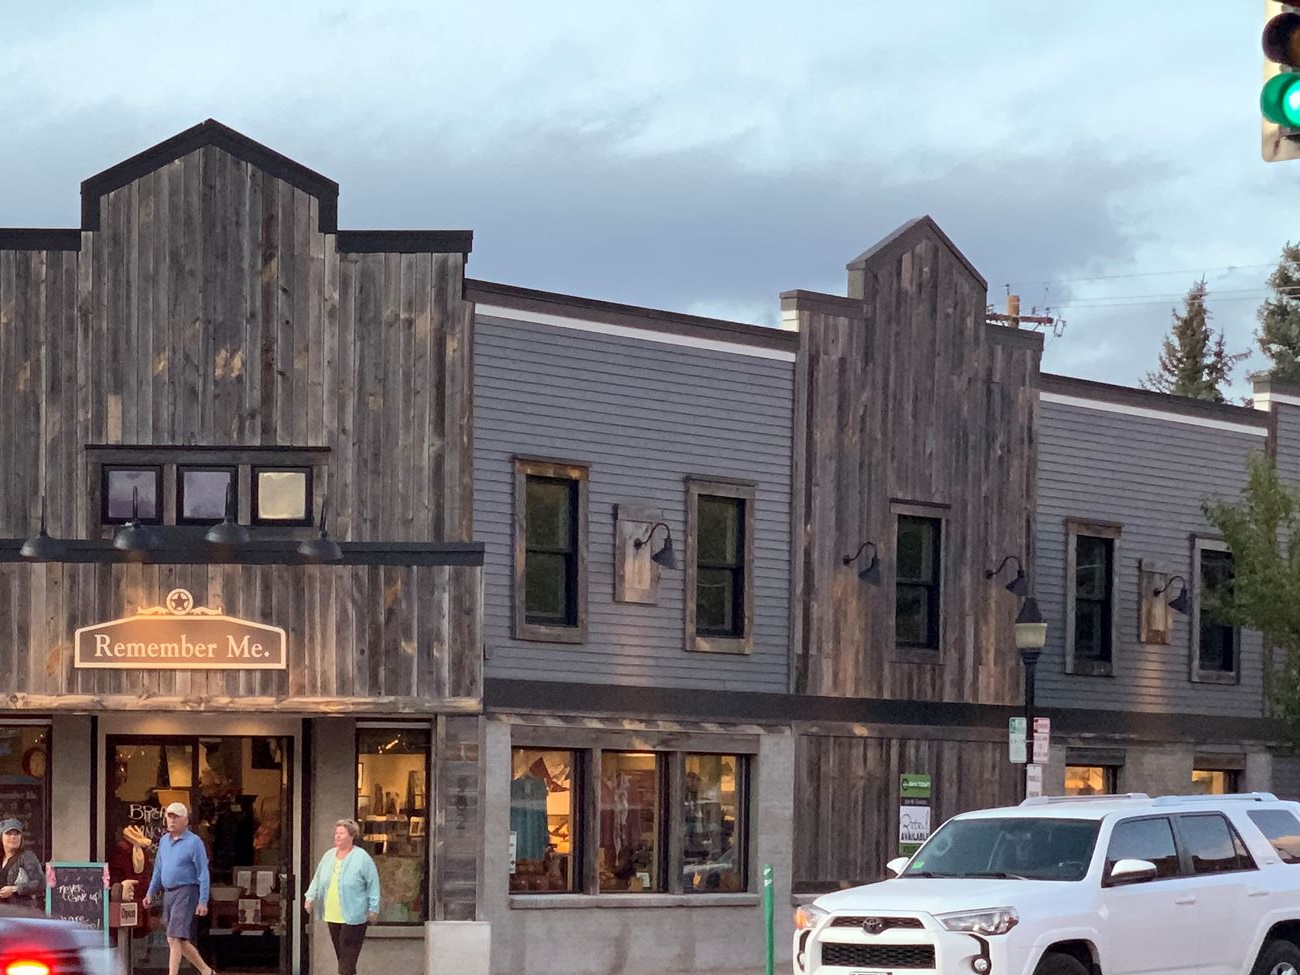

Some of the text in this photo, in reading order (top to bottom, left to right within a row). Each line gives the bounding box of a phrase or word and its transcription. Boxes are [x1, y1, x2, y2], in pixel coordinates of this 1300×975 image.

[94, 634, 270, 658] Remember Me.
[121, 908, 136, 921] Open
